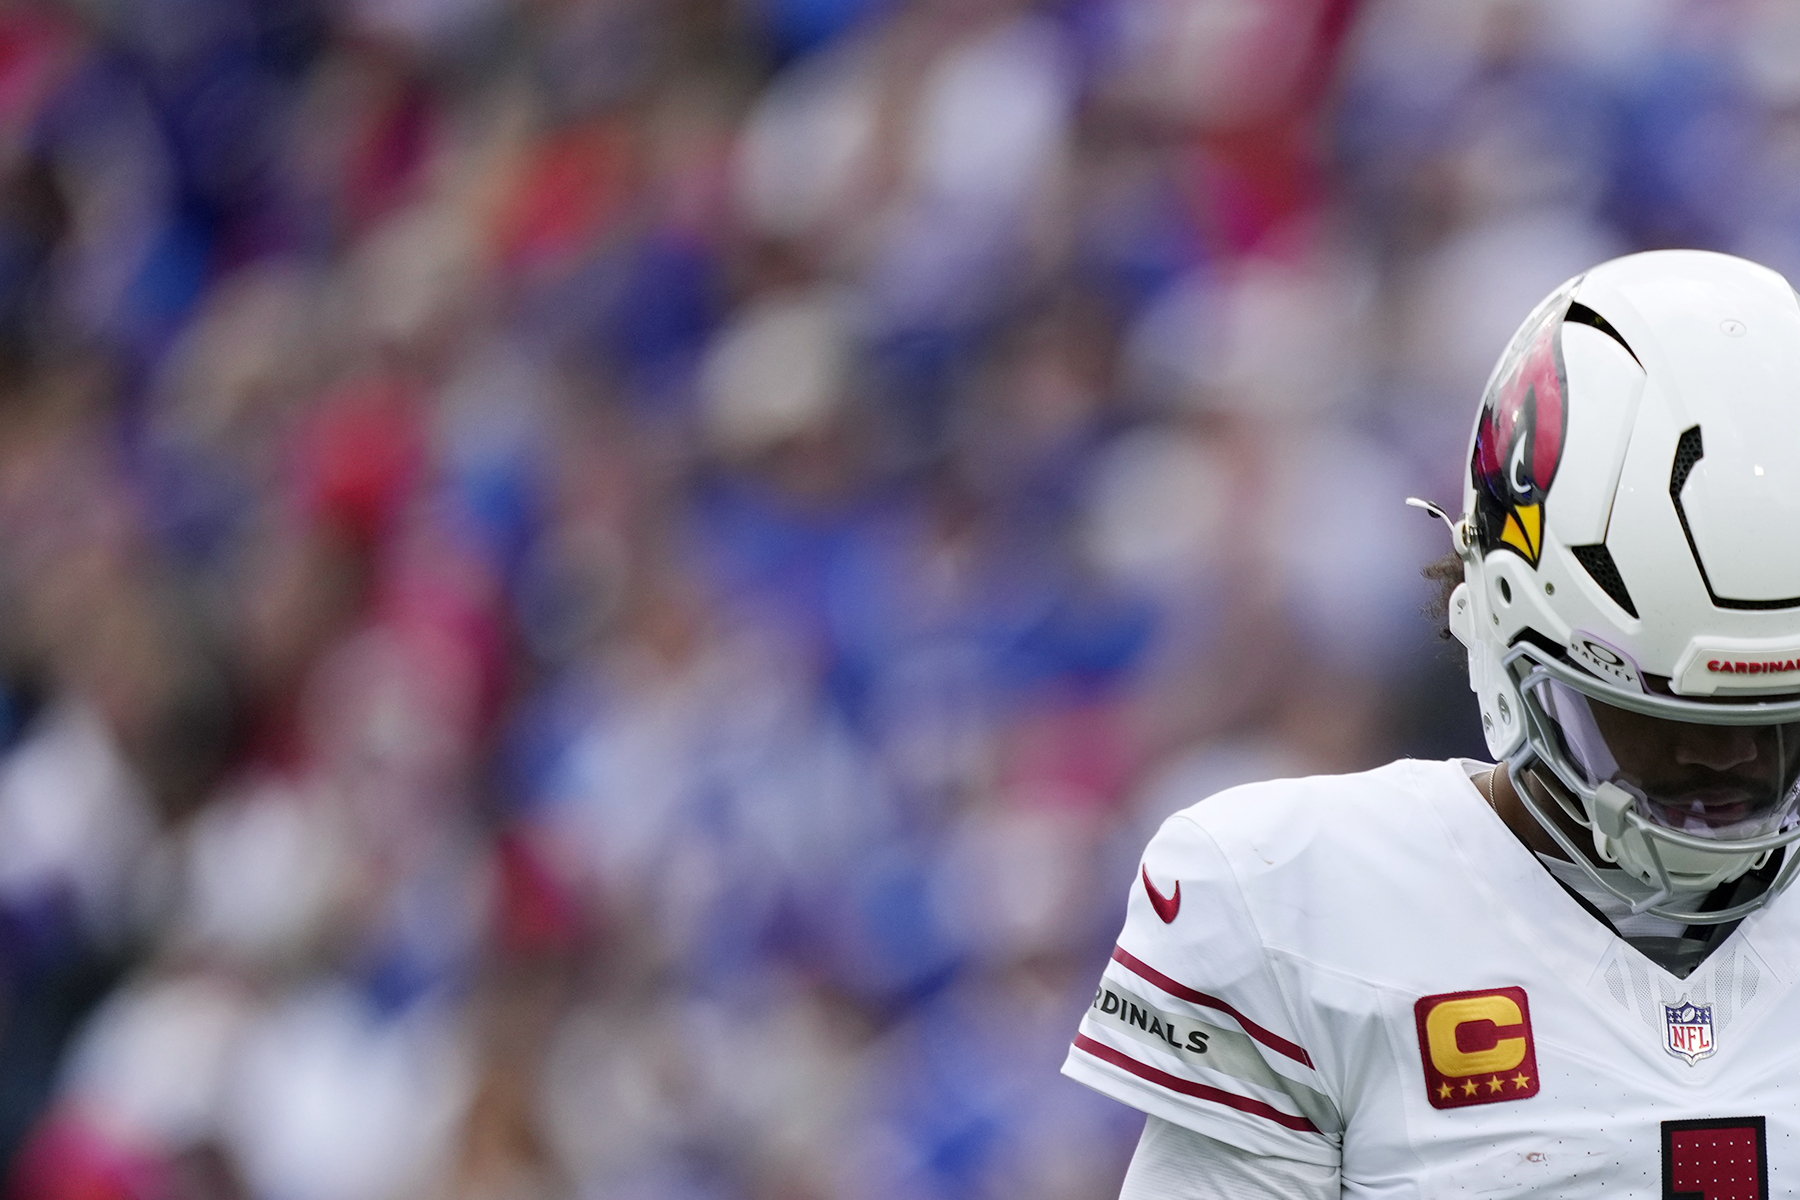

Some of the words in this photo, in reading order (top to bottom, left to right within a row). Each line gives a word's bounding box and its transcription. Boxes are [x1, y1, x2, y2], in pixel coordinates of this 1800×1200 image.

[1571, 643, 1637, 683] OAKLEY
[1426, 995, 1527, 1078] C
[1672, 1026, 1710, 1052] NFL
